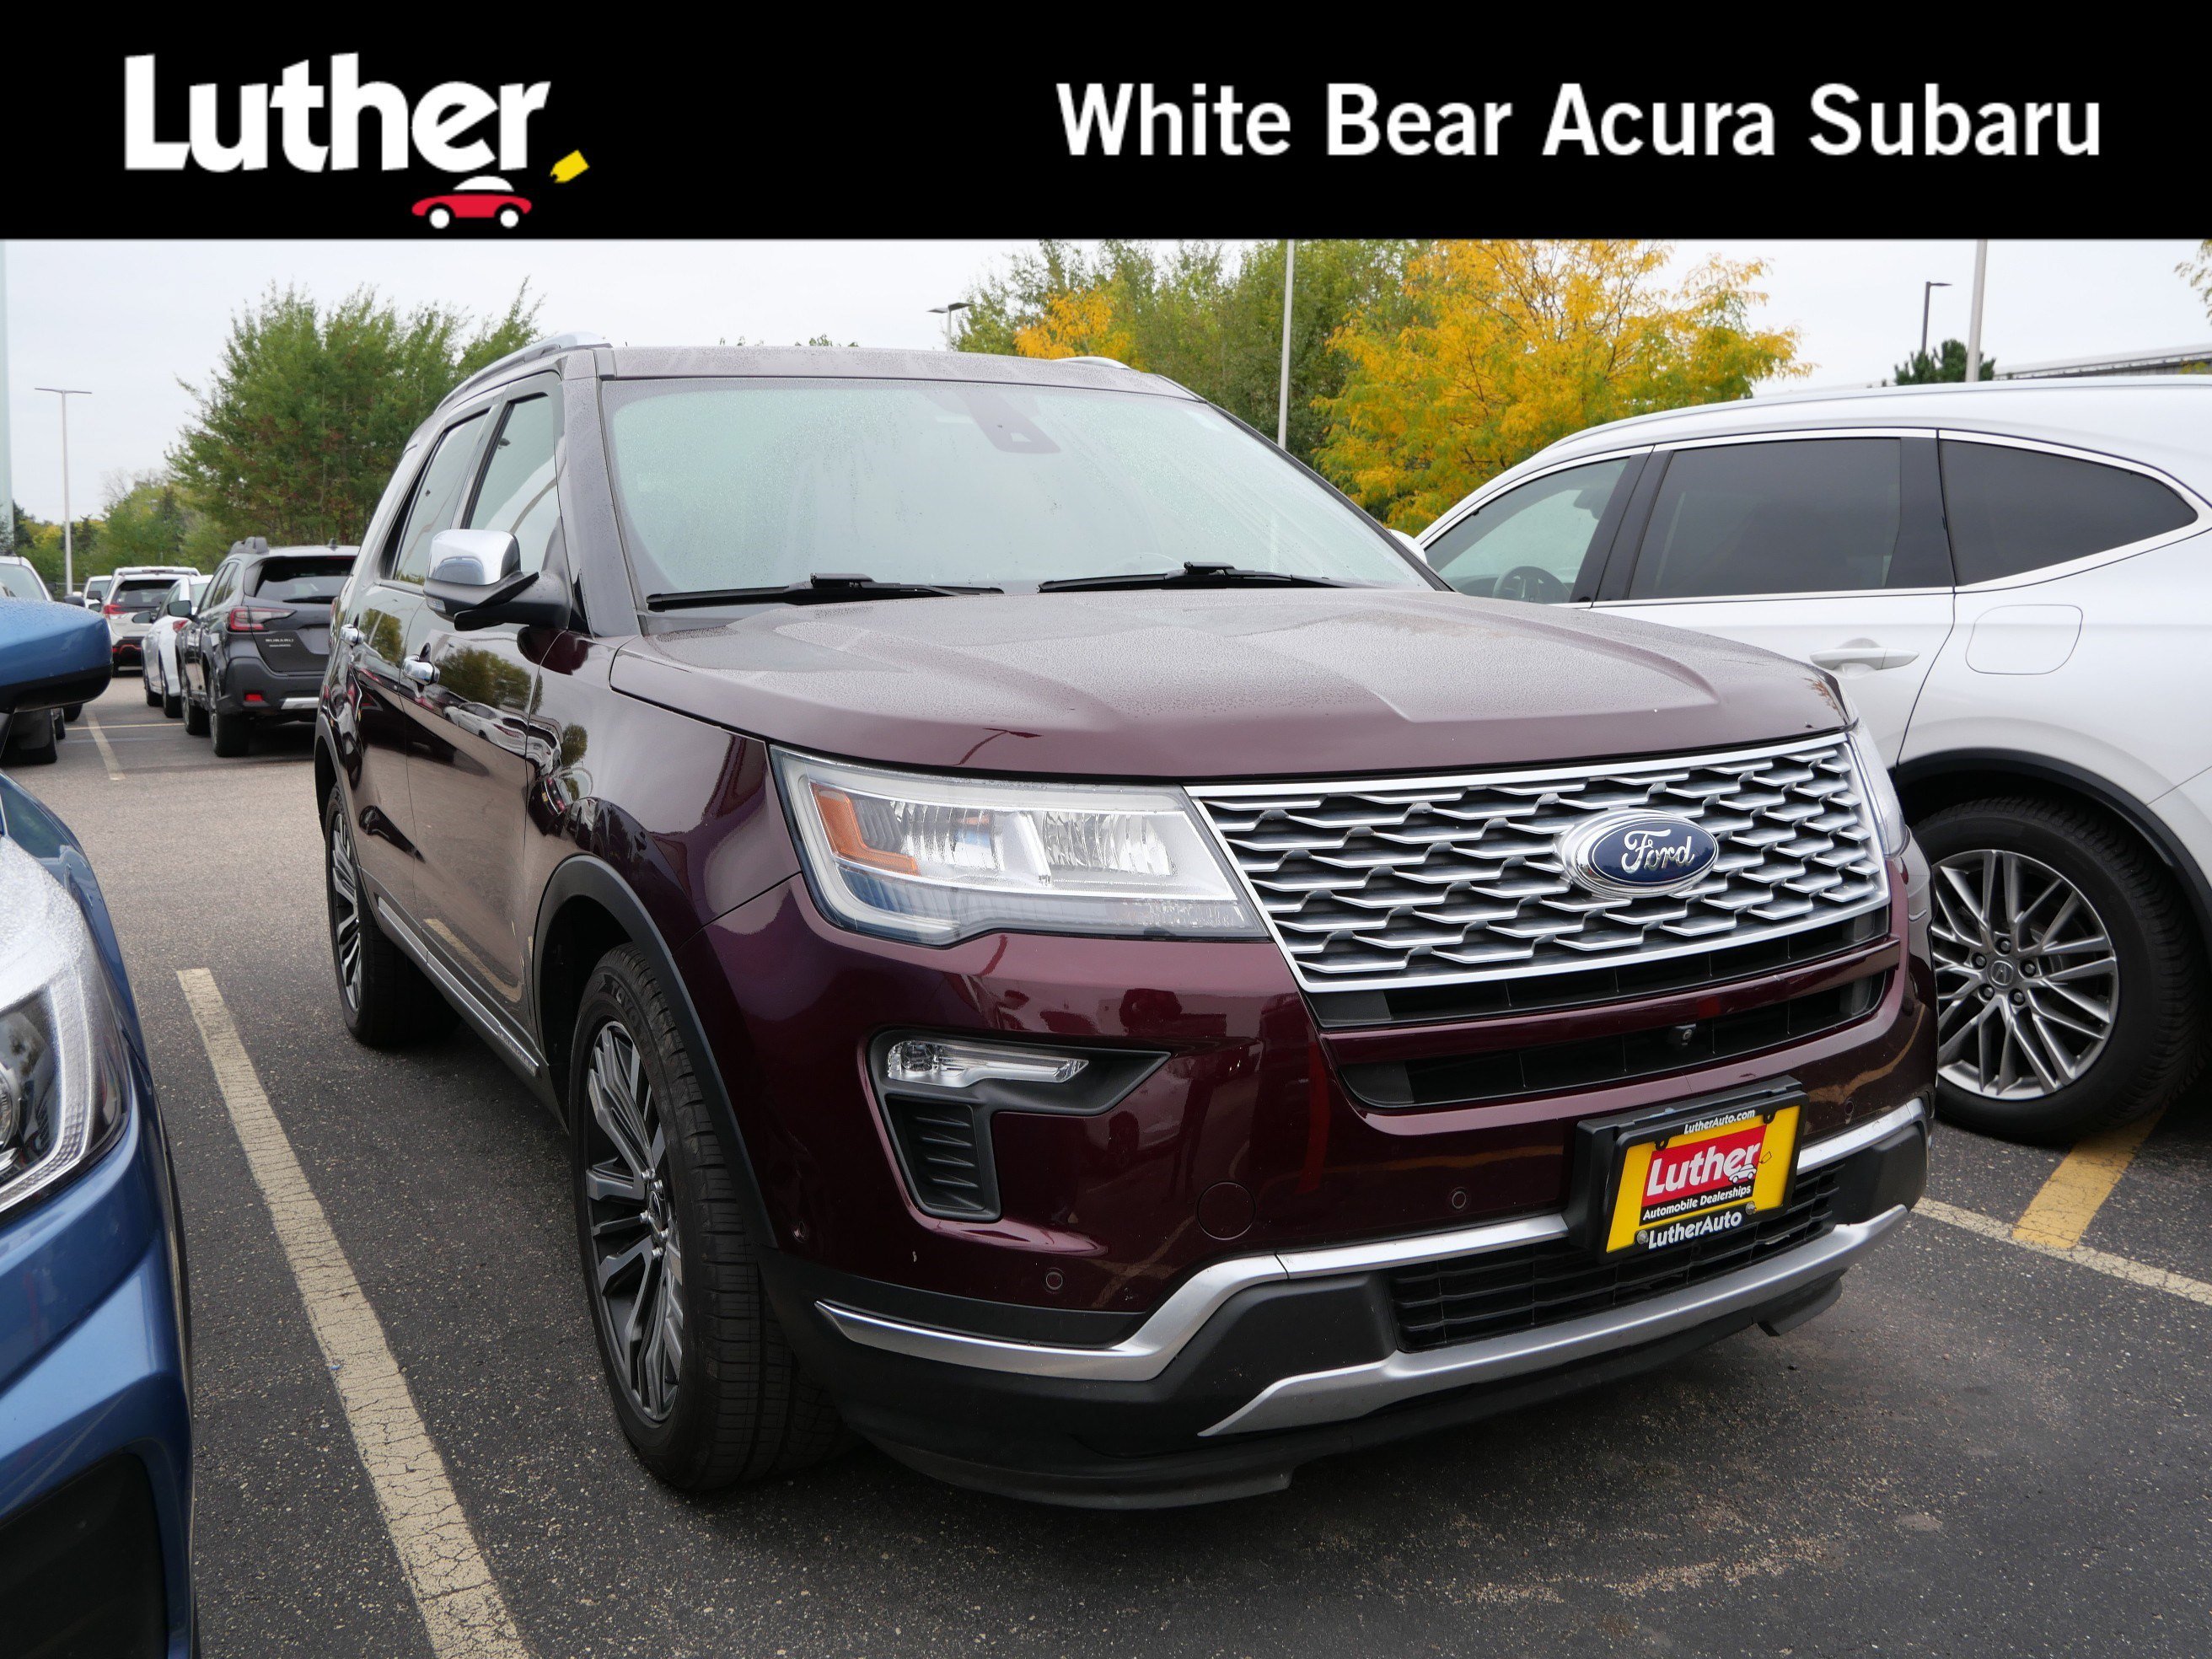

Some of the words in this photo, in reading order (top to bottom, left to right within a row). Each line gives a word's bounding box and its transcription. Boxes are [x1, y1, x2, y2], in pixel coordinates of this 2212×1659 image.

[1621, 829, 1695, 873] Ford
[1683, 1109, 1755, 1135] LutherAuto.com
[1646, 1142, 1760, 1196] Luther
[1643, 1198, 1698, 1221] Automobile
[1699, 1184, 1752, 1205] Dealerships
[1648, 1211, 1742, 1249] LutherAuto
